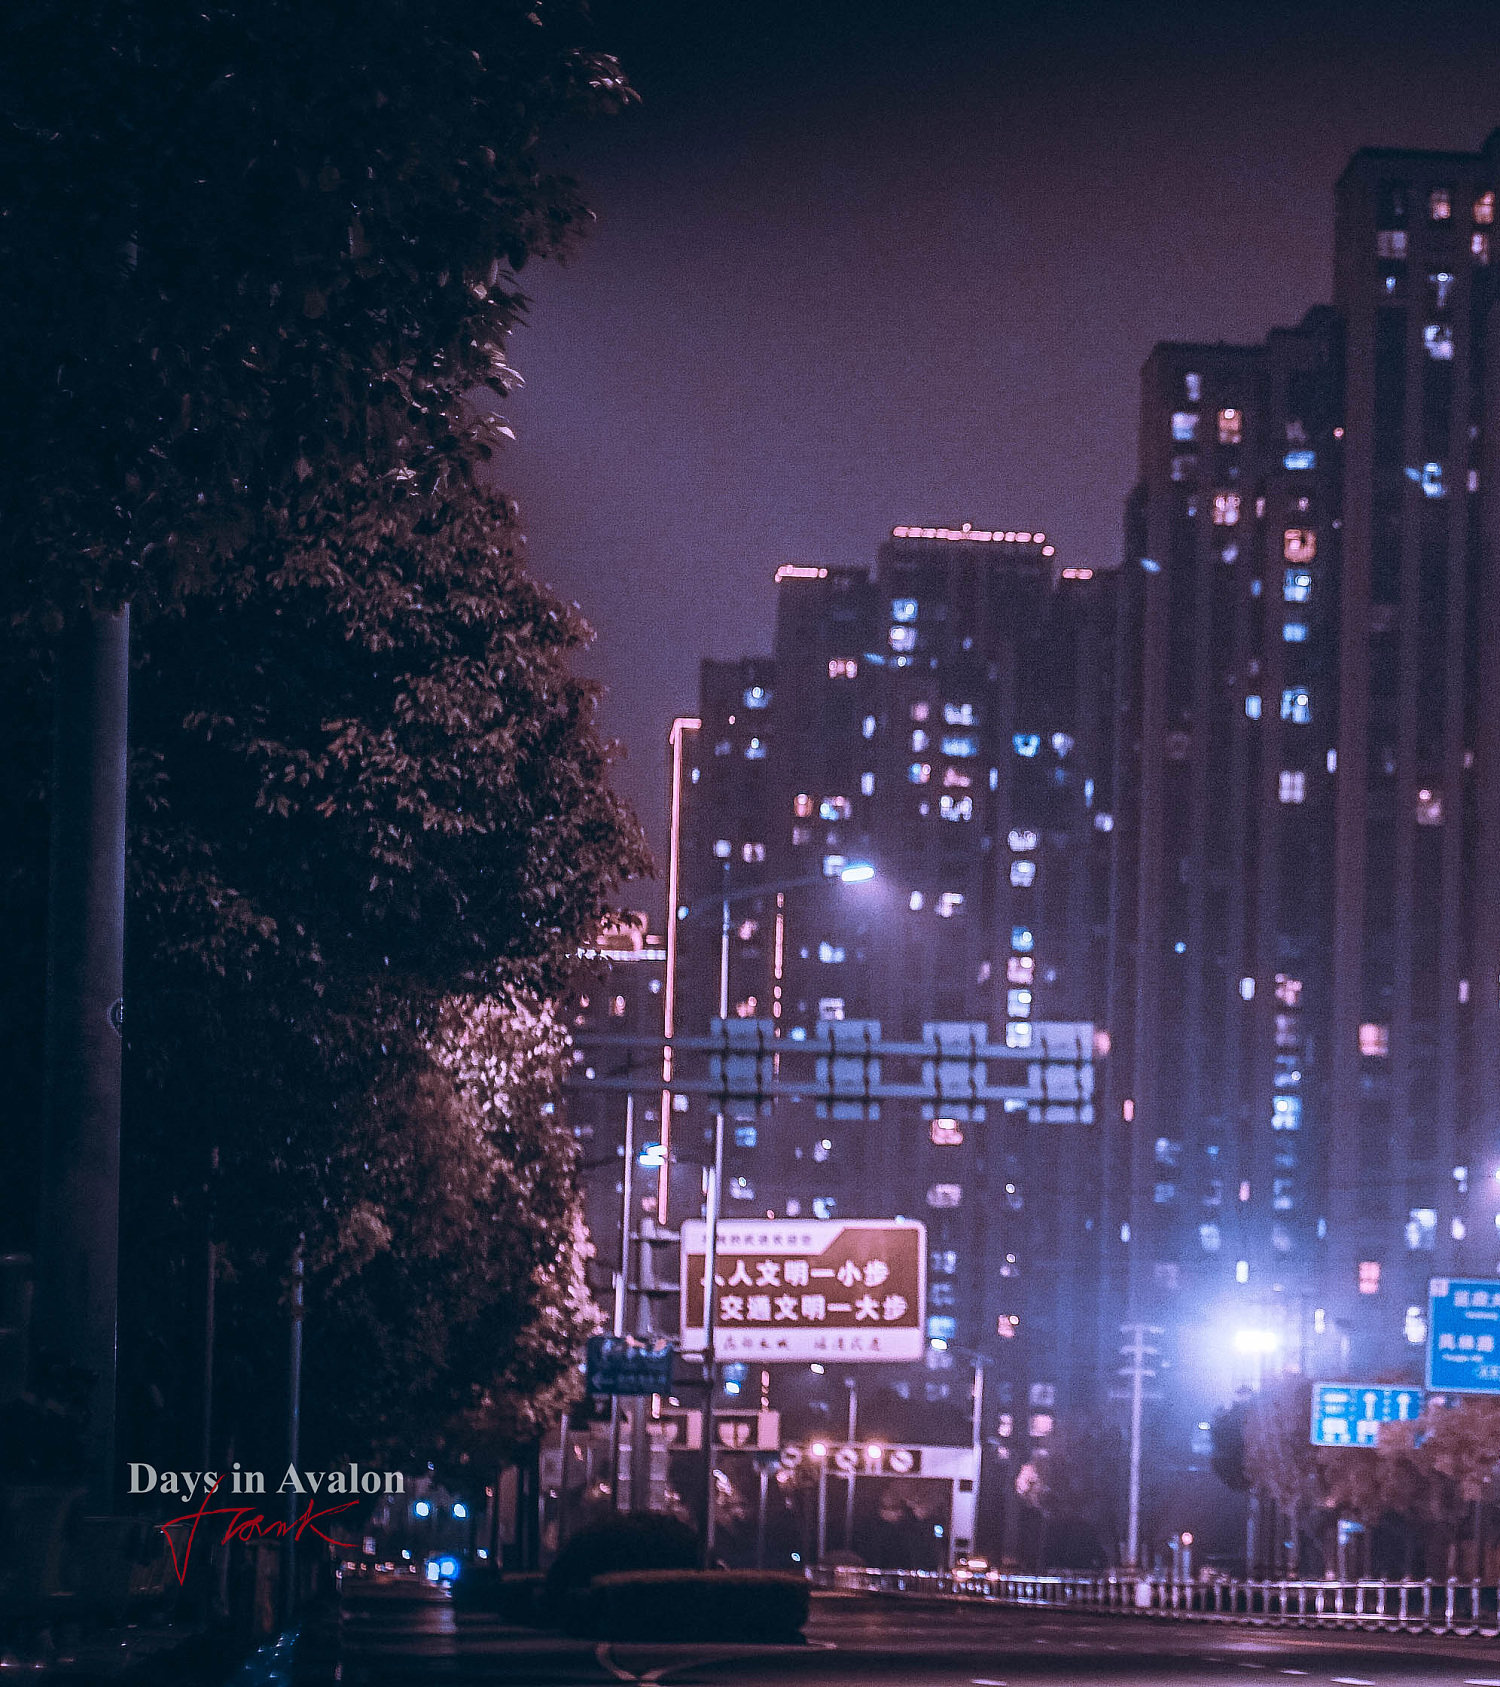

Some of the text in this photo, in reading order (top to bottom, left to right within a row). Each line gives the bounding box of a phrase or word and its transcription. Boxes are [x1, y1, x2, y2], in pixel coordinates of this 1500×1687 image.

[719, 1293, 909, 1321] 交通文明一大步
